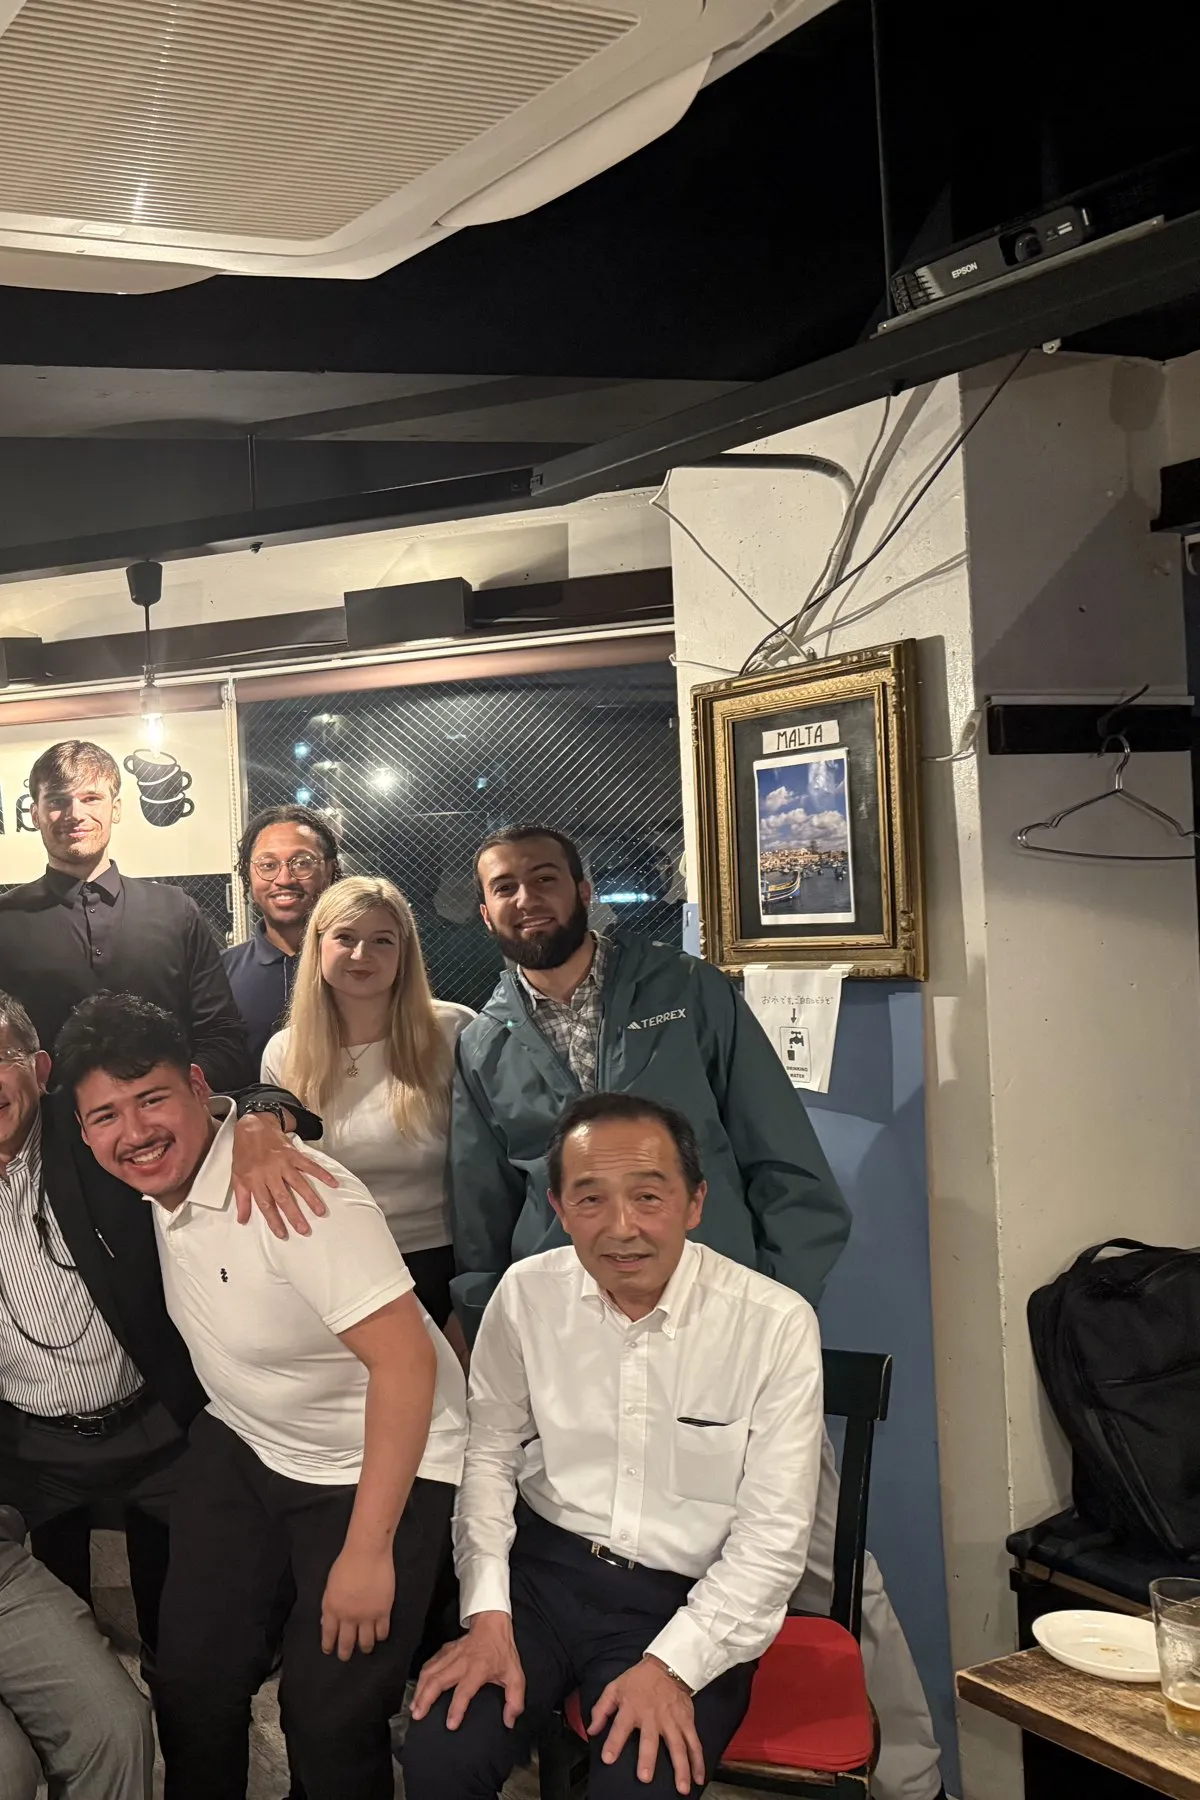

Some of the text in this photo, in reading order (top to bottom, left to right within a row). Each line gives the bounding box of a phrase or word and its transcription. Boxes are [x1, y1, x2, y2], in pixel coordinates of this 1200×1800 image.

[951, 261, 978, 279] EPSON
[777, 724, 822, 750] MALTA
[640, 1008, 687, 1029] TERREX
